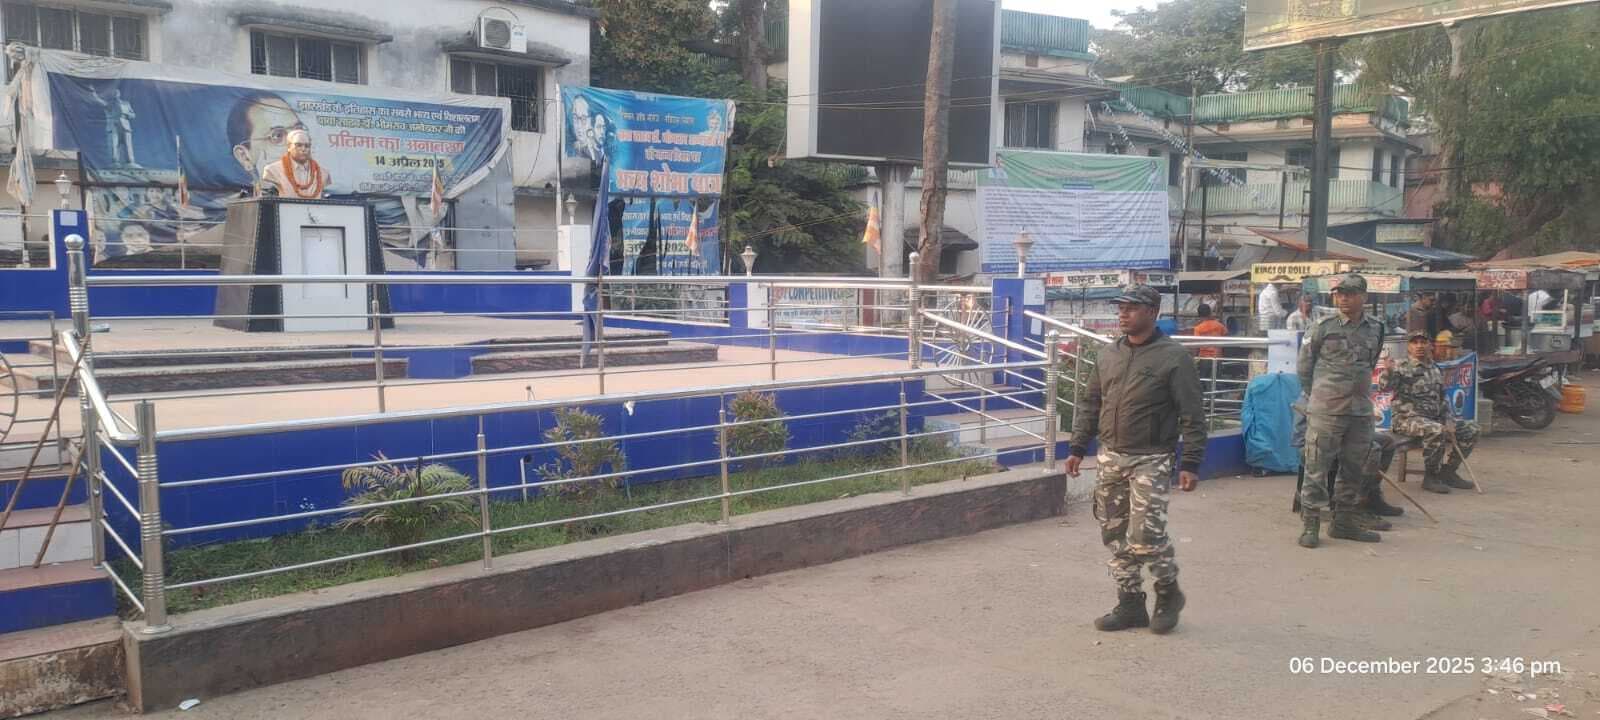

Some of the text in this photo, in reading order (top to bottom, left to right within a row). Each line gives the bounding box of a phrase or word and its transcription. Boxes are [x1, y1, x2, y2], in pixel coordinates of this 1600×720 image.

[391, 107, 412, 119] सबसे
[328, 130, 465, 154] प्रतिमा का अनावरण
[375, 156, 386, 166] 14
[616, 169, 649, 192] भव्य
[650, 162, 689, 193] शोभा
[1277, 265, 1287, 274] OF
